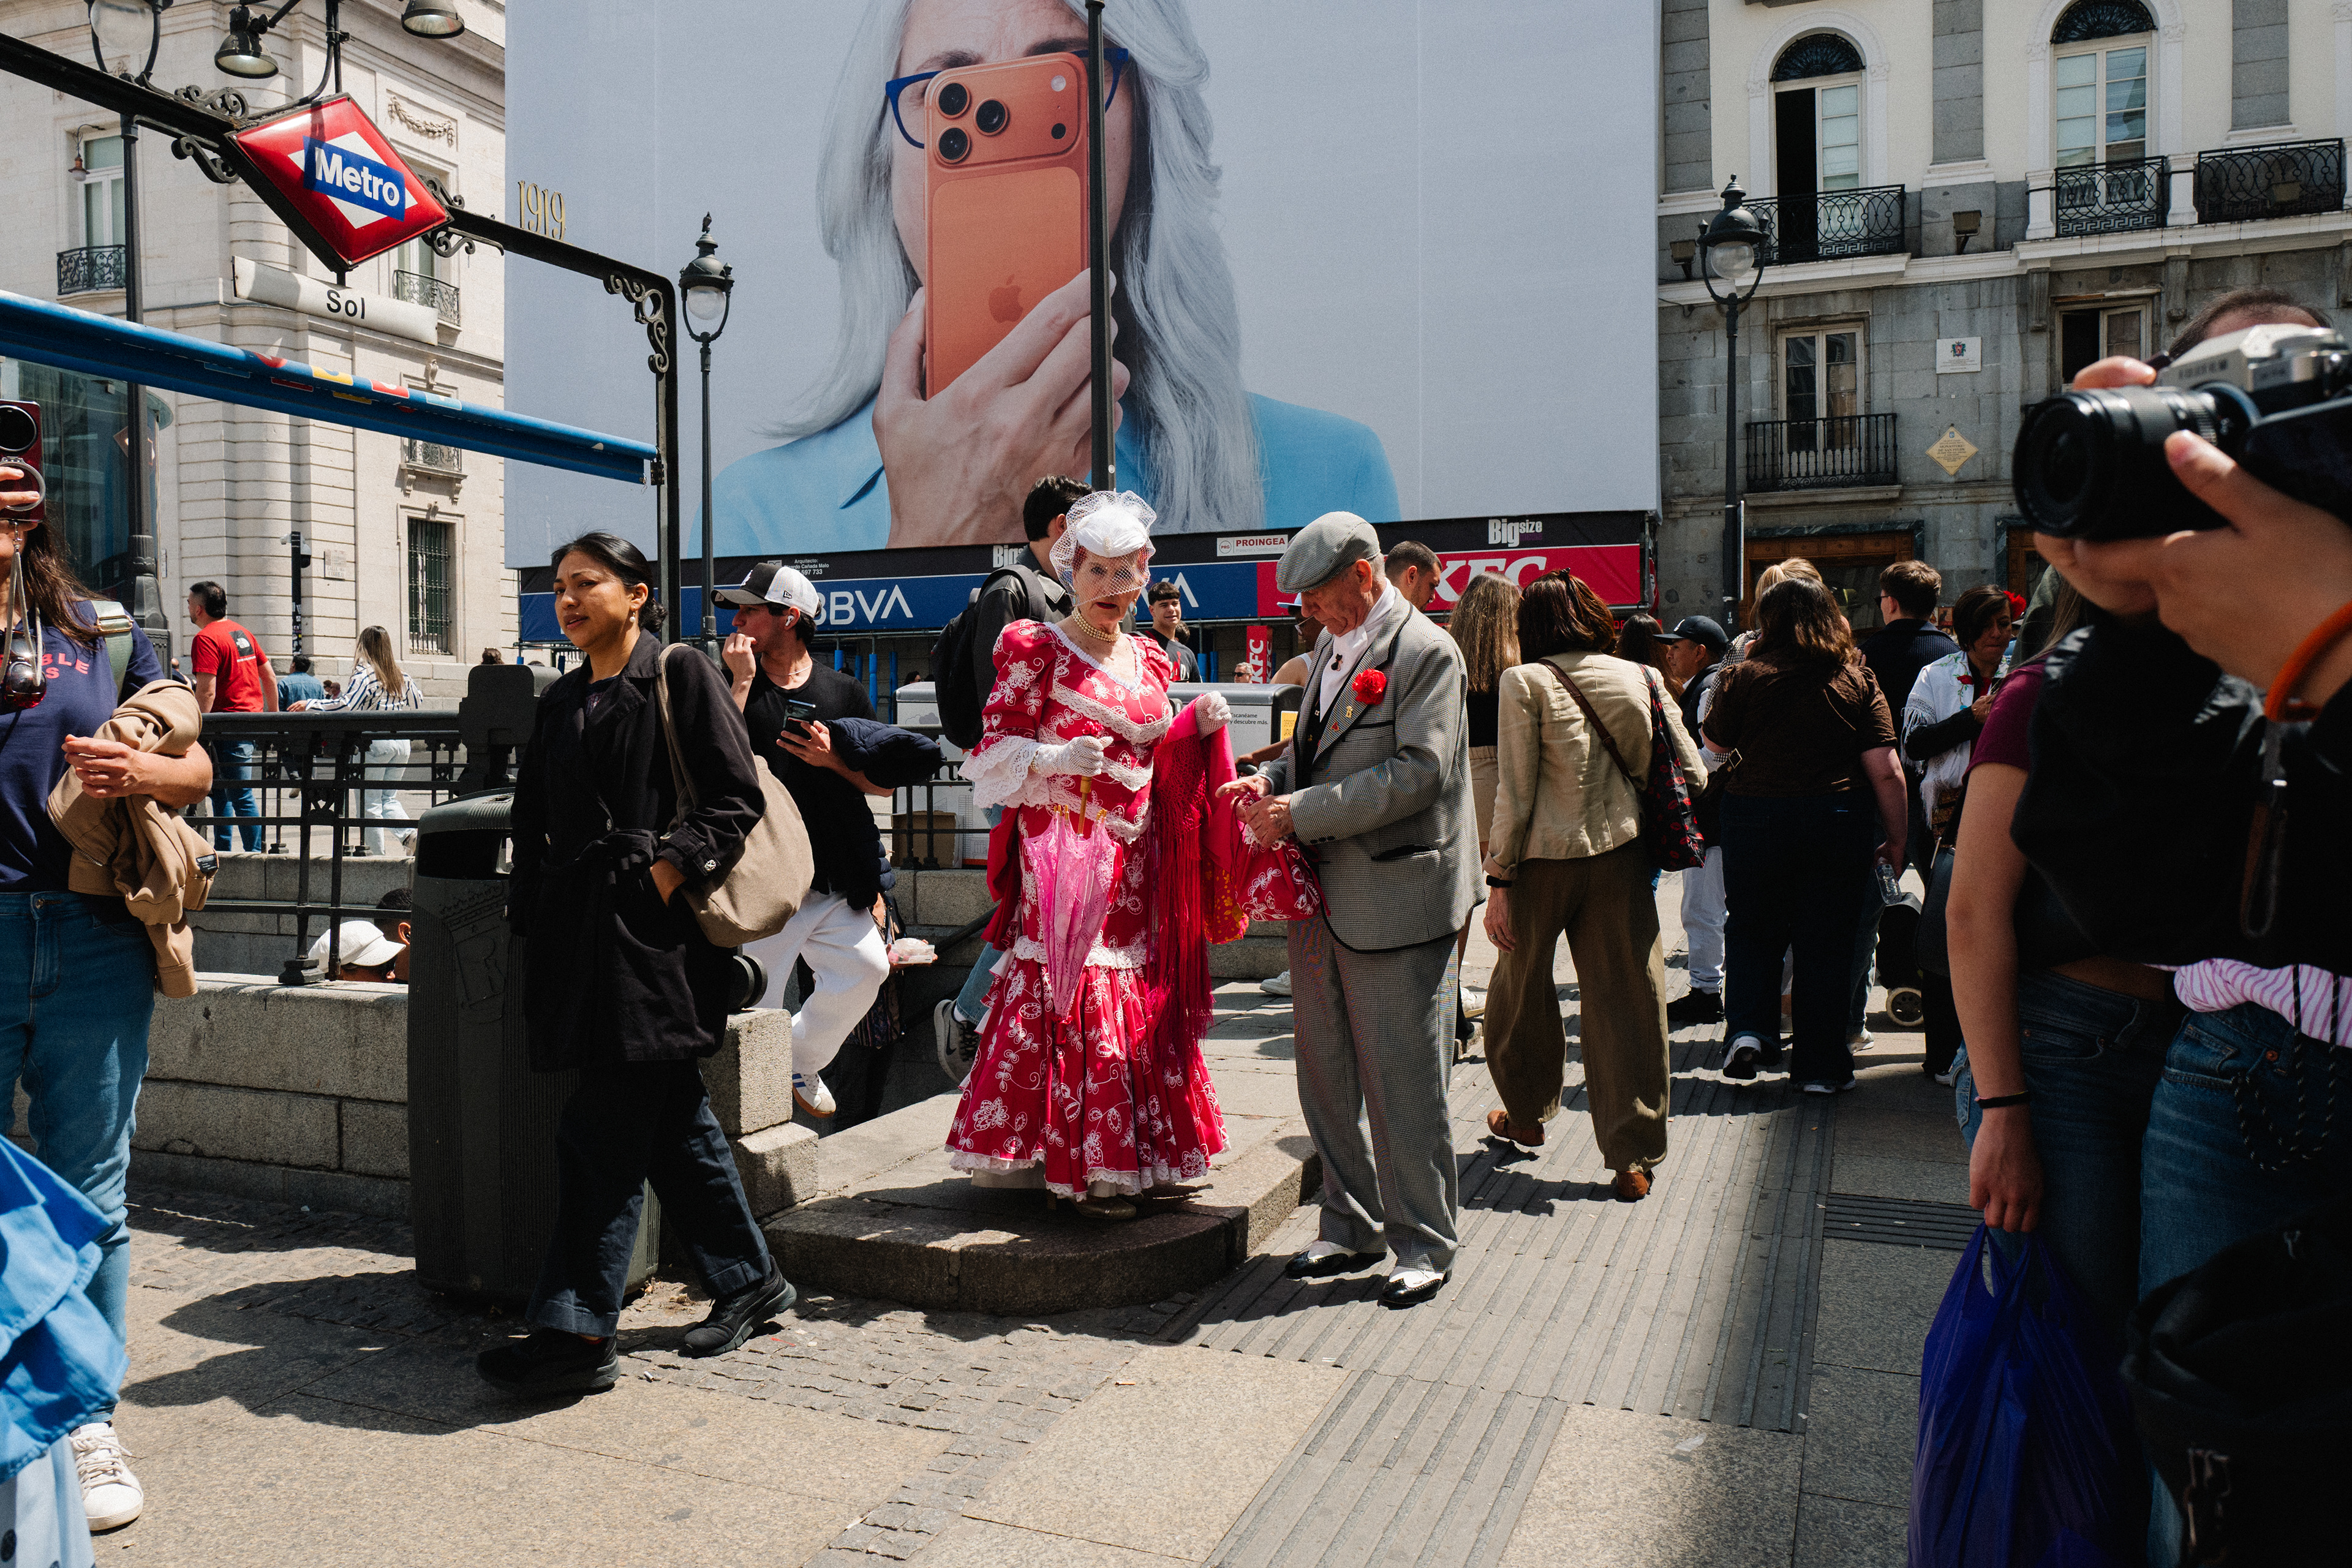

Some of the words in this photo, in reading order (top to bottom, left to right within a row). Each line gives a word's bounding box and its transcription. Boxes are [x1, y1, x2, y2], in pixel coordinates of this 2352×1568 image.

[315, 147, 400, 206] Metro
[518, 180, 566, 241] 1919
[326, 289, 365, 319] Sol
[1236, 538, 1286, 547] PROINGEA
[1250, 639, 1264, 684] KFC
